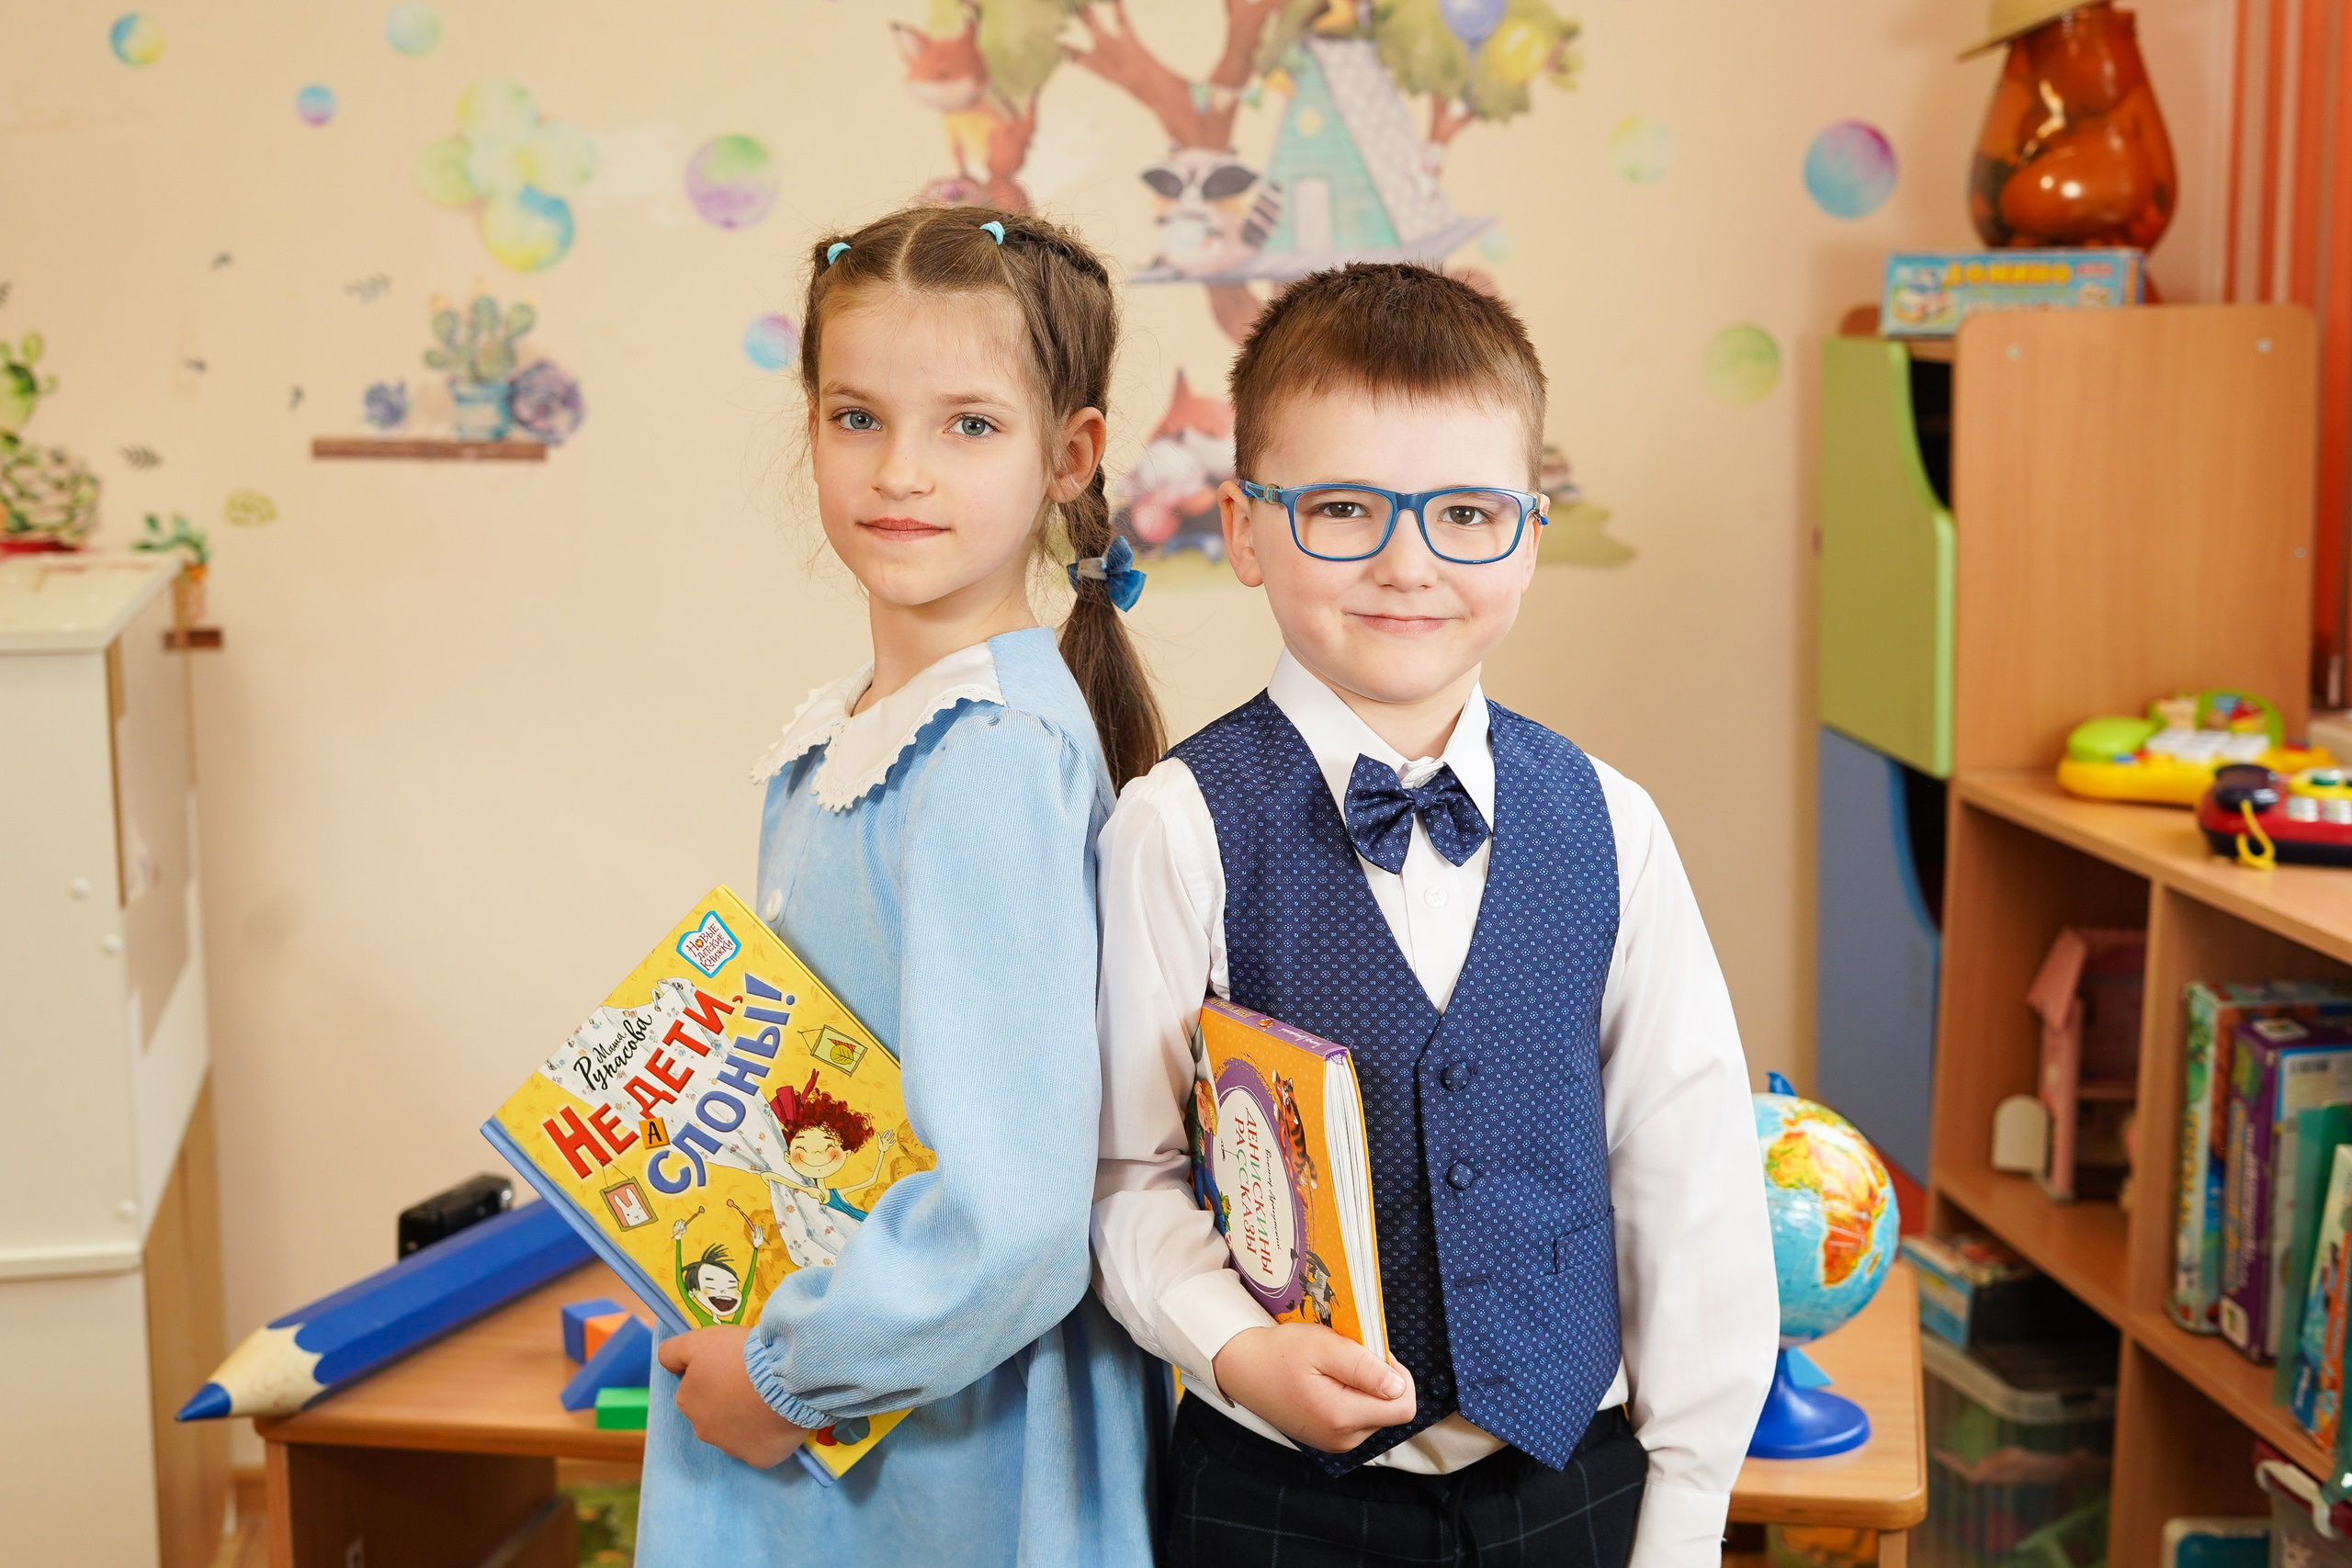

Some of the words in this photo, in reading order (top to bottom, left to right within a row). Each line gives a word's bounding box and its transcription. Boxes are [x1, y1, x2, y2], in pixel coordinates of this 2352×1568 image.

[697, 932, 725, 963] ДЕТСКИЕ
[700, 940, 734, 971] КНИЖКИ
[542, 1102, 640, 1179] НЕ
[623, 989, 743, 1120] ДЕТИ,
[572, 1014, 653, 1091] Рупасова
[592, 1032, 628, 1064] Маша
[647, 972, 796, 1194] СЛОНЫ!
[647, 1120, 663, 1145] А
[1234, 1115, 1258, 1256] РАССКАЗЫ
[1245, 1107, 1274, 1277] ДЕНИСКИНЫ
